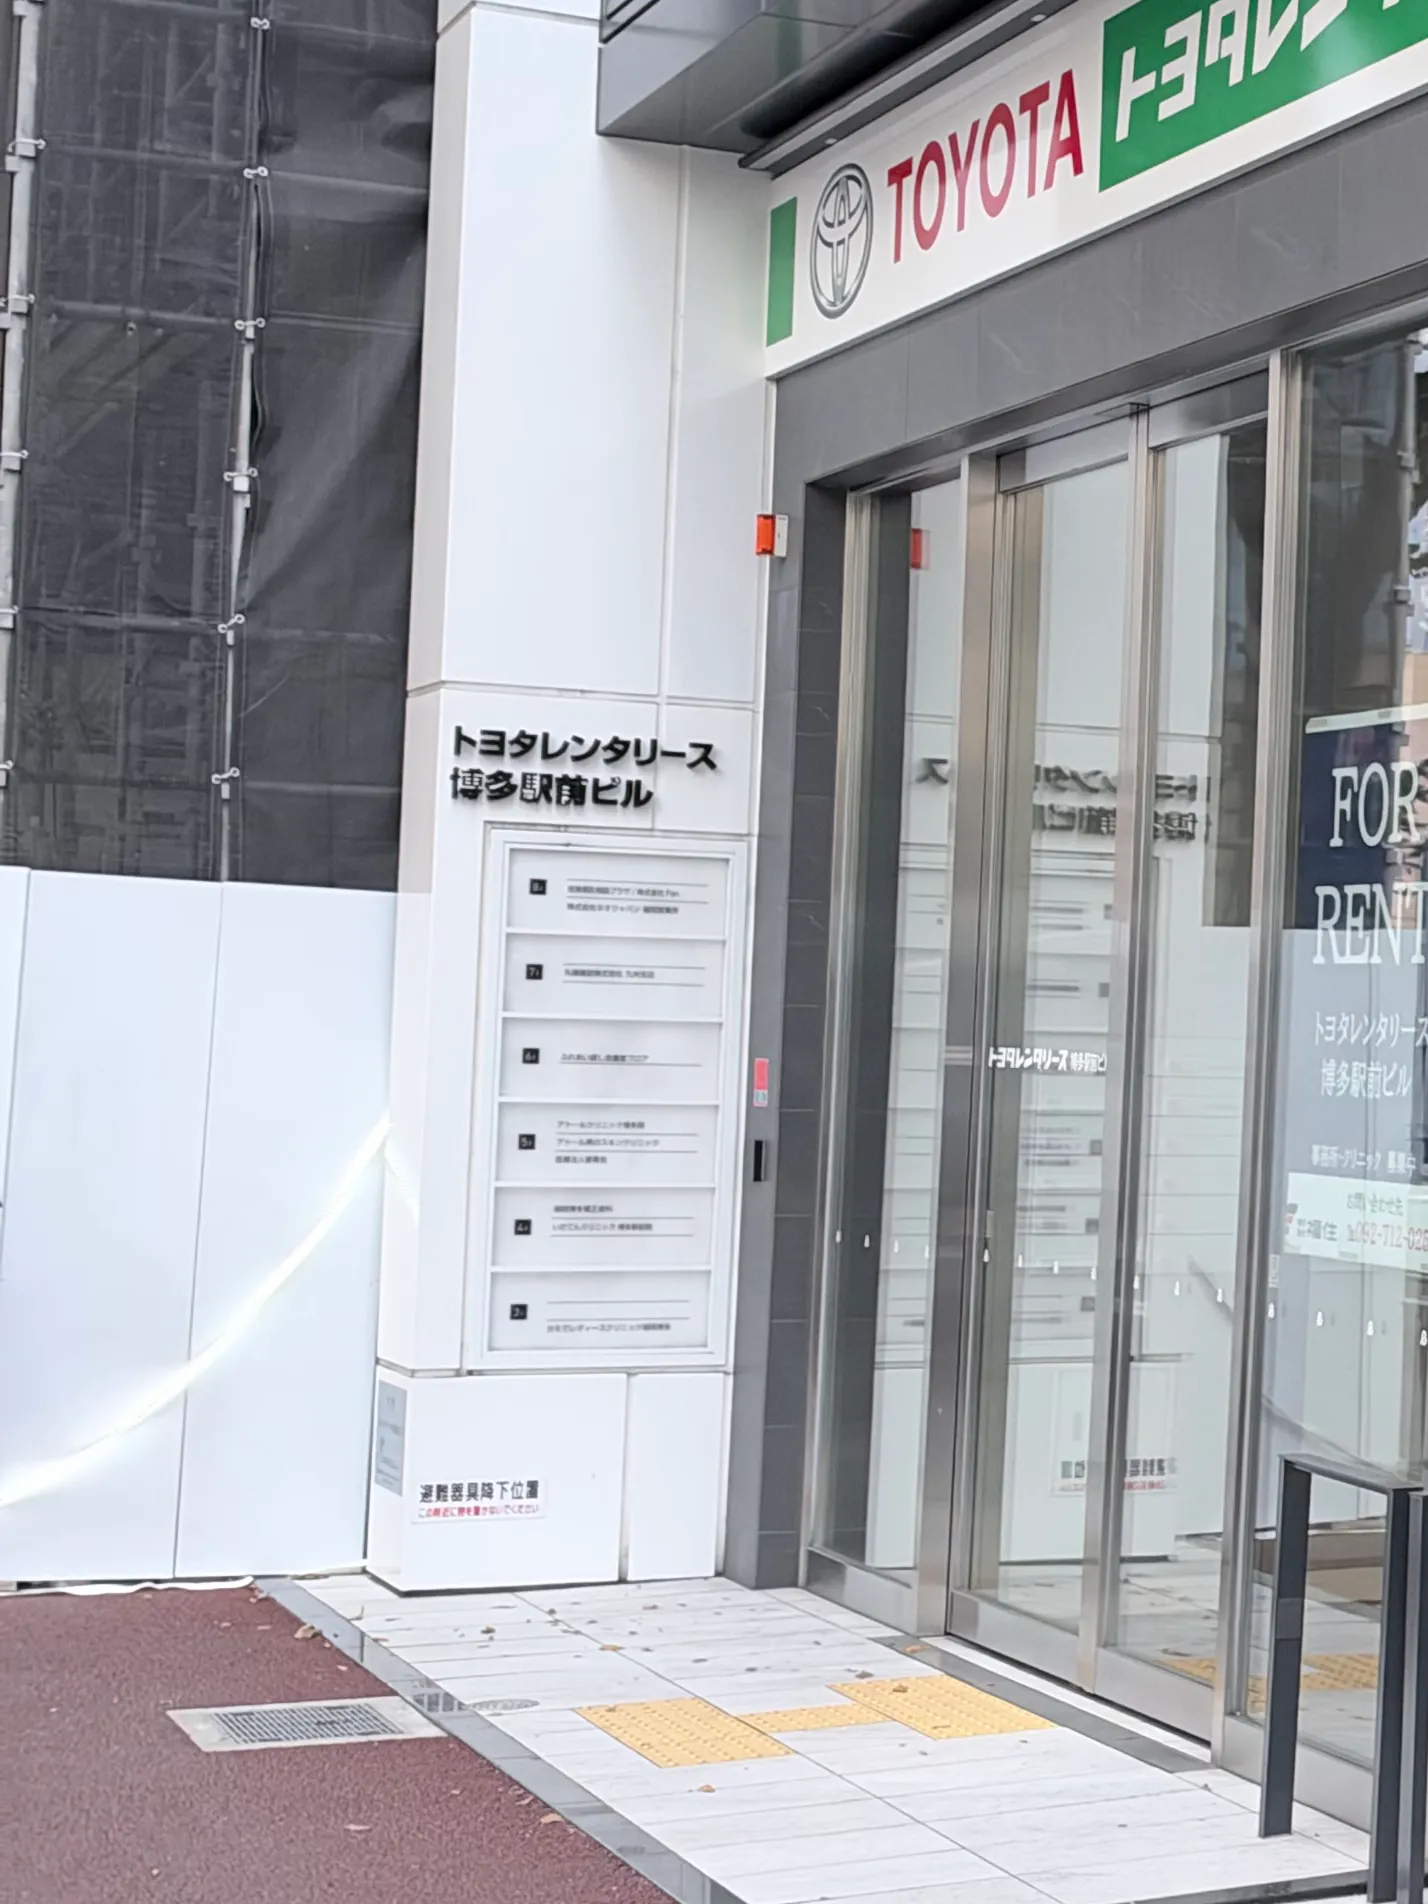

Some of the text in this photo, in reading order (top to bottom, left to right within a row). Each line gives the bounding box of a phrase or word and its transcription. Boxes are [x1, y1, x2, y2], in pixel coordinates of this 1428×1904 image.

[887, 69, 1084, 263] TOYOTA
[454, 725, 718, 771] トヨタレンタリース
[450, 766, 654, 808] 博多駅前ビル
[1329, 761, 1421, 848] FOR
[988, 1047, 1068, 1072] トヨタレンタリース
[1321, 1058, 1412, 1099] 博多駅前ビル
[420, 1480, 539, 1504] 避難器具降下位置
